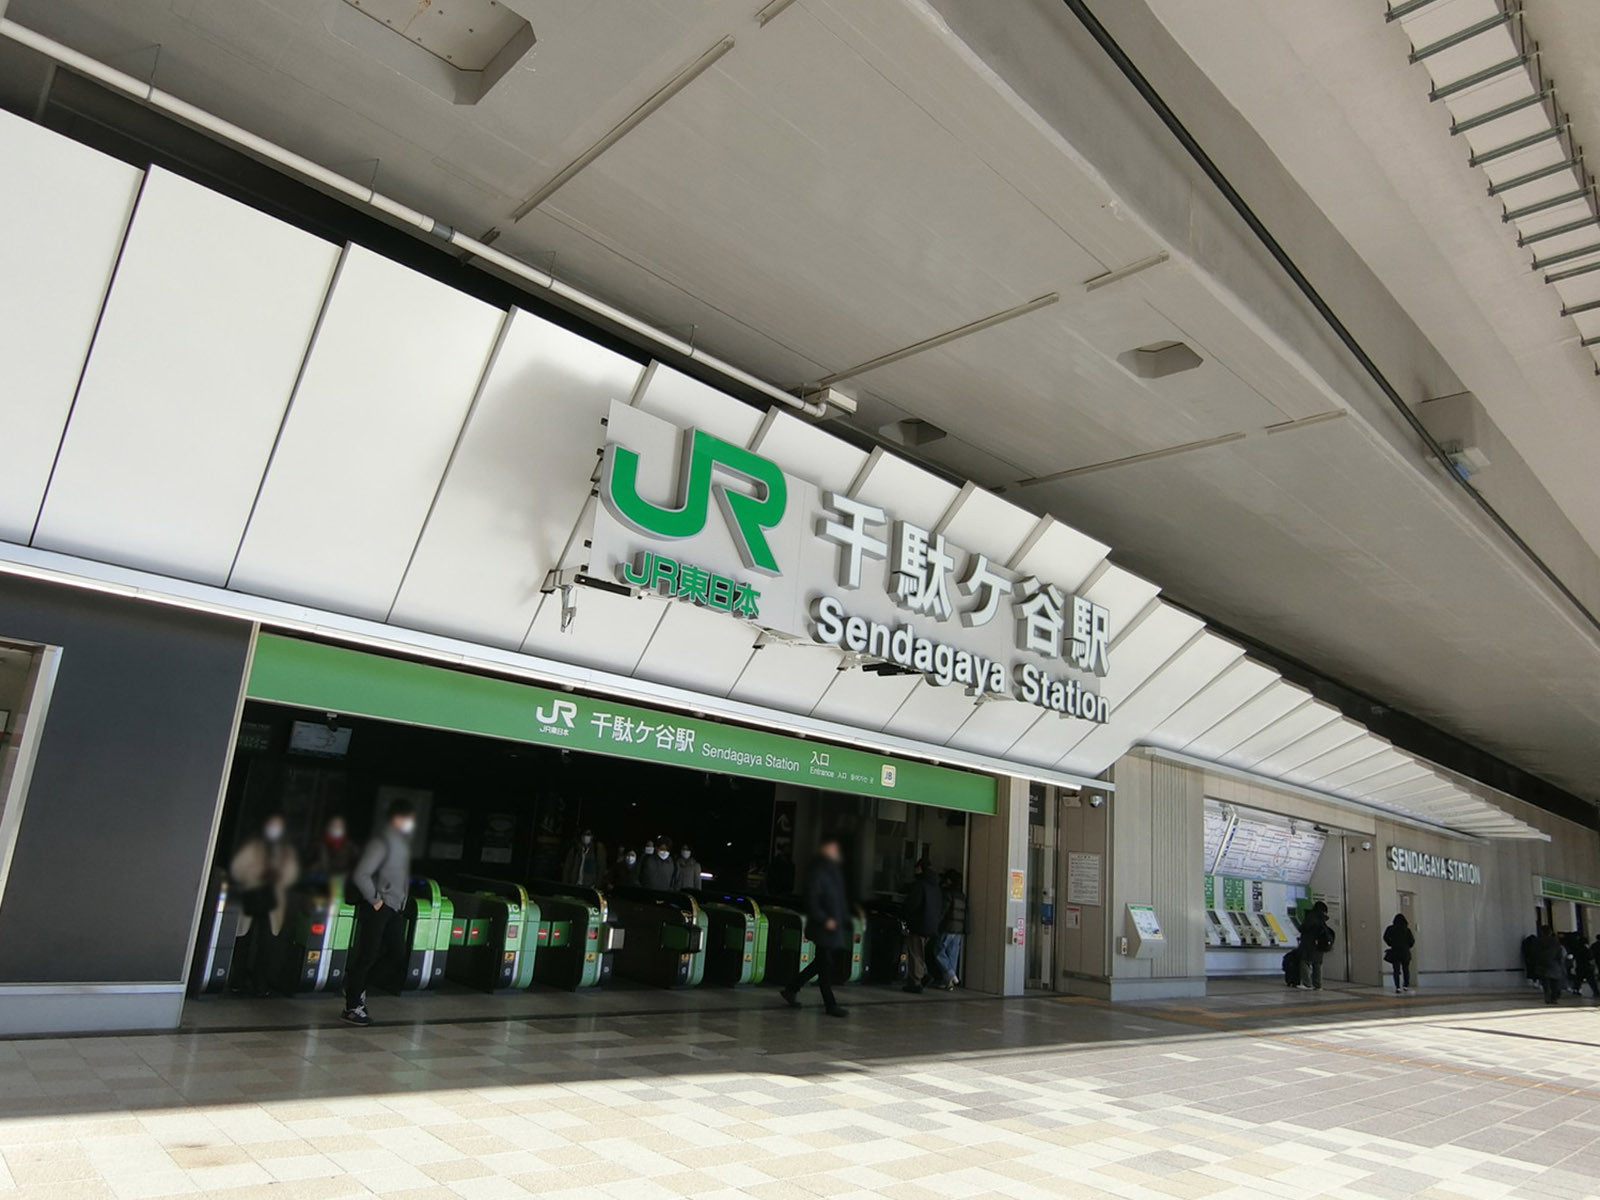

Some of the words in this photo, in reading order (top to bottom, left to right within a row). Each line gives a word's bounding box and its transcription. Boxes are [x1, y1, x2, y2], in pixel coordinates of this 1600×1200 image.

[607, 427, 788, 573] JR
[622, 551, 763, 618] JR東日本
[816, 597, 1007, 697] Sendagaya
[1020, 661, 1111, 725] Station
[535, 698, 578, 729] JR
[701, 742, 763, 767] Sendagaya
[764, 753, 800, 772] Station
[808, 766, 835, 779] Entrance
[809, 750, 831, 767] 入口
[1390, 845, 1448, 880] SENDAGAYA
[1447, 858, 1481, 886] STATION
